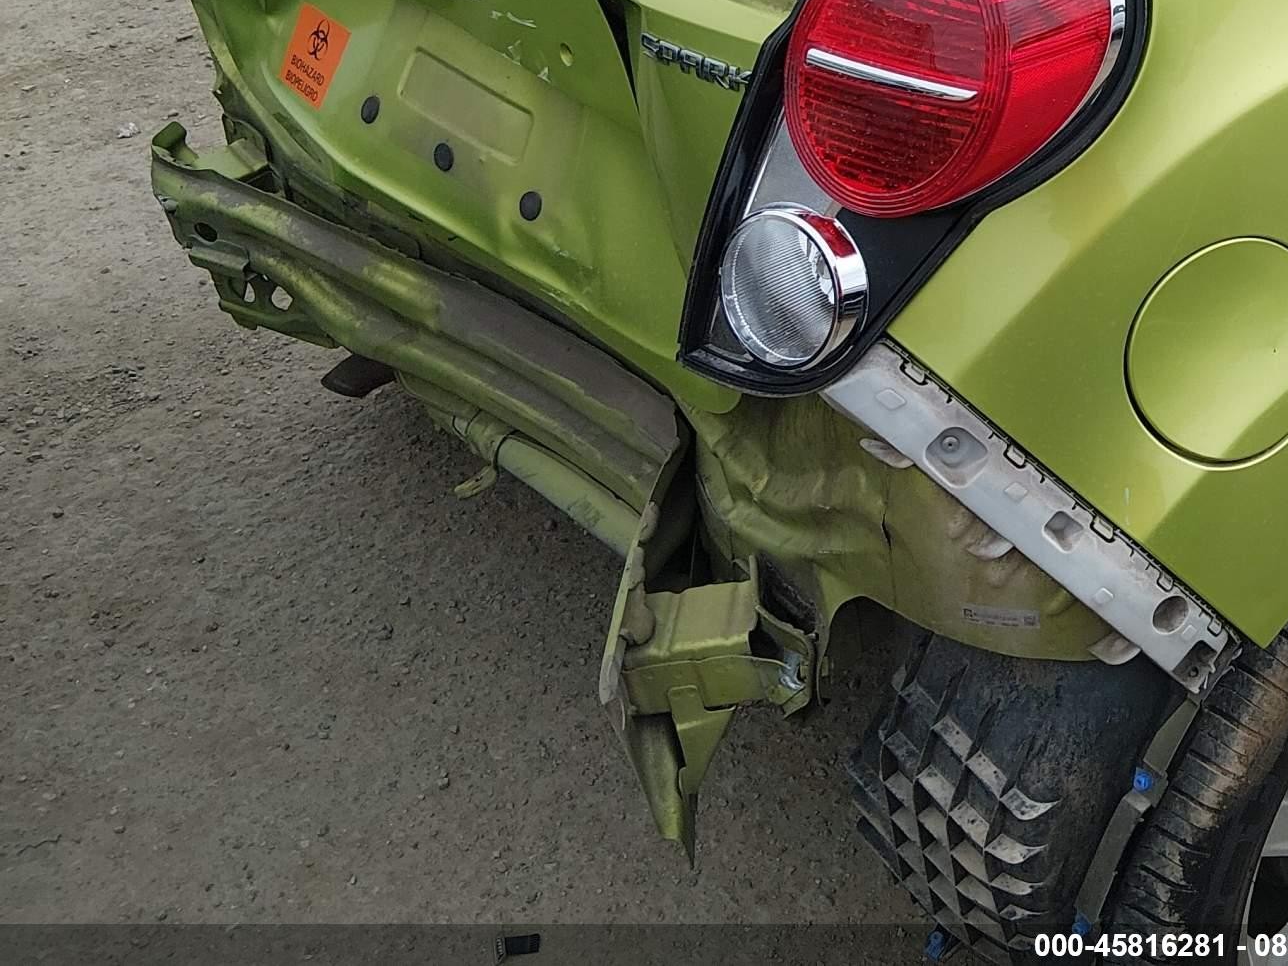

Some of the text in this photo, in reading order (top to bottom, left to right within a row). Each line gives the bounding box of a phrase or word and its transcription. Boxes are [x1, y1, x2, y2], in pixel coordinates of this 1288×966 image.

[290, 54, 325, 87] BIOHAZARD
[641, 32, 752, 92] SPARK
[285, 69, 319, 102] BIOPELIGRO
